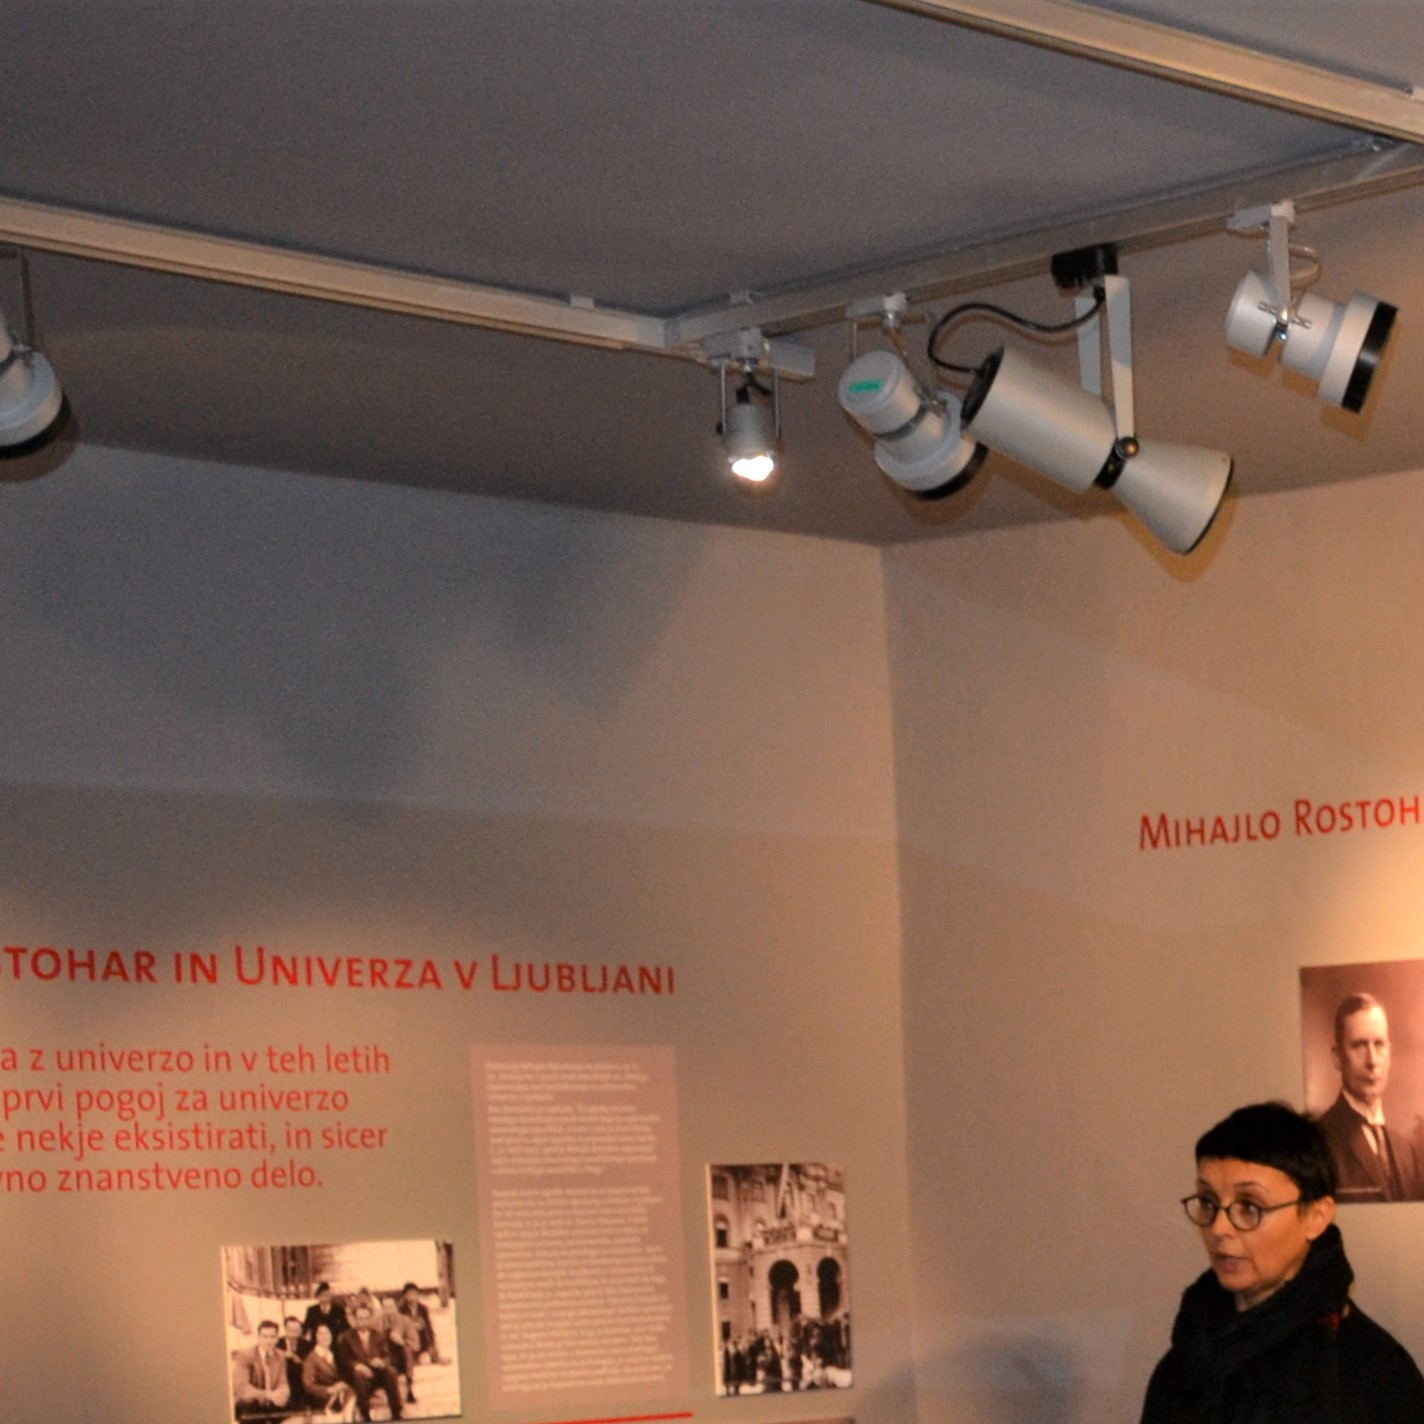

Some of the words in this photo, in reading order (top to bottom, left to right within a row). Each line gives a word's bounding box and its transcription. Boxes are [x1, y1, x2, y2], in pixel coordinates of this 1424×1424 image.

[1138, 810, 1282, 851] MIHAJLO
[0, 945, 157, 983] TOHAR
[173, 952, 219, 985] IN
[233, 945, 444, 991] UNIVERZA
[489, 954, 676, 995] LJUBLJANI
[29, 1048, 45, 1071] z
[55, 1043, 195, 1072] univerzo
[203, 1043, 232, 1072] in
[240, 1051, 258, 1072] v
[265, 1044, 316, 1073] teh
[325, 1044, 391, 1073] letih
[2, 1082, 64, 1121] prvi
[75, 1083, 165, 1121] pogoj
[175, 1088, 209, 1111] za
[219, 1083, 349, 1111] univerzo
[16, 1121, 105, 1161] nekje
[113, 1122, 276, 1154] eksistirati,
[284, 1122, 313, 1150] in
[322, 1122, 389, 1150] sicer
[0, 1168, 47, 1193] no
[57, 1161, 242, 1192] znanstveno
[250, 1159, 323, 1190] delo.
